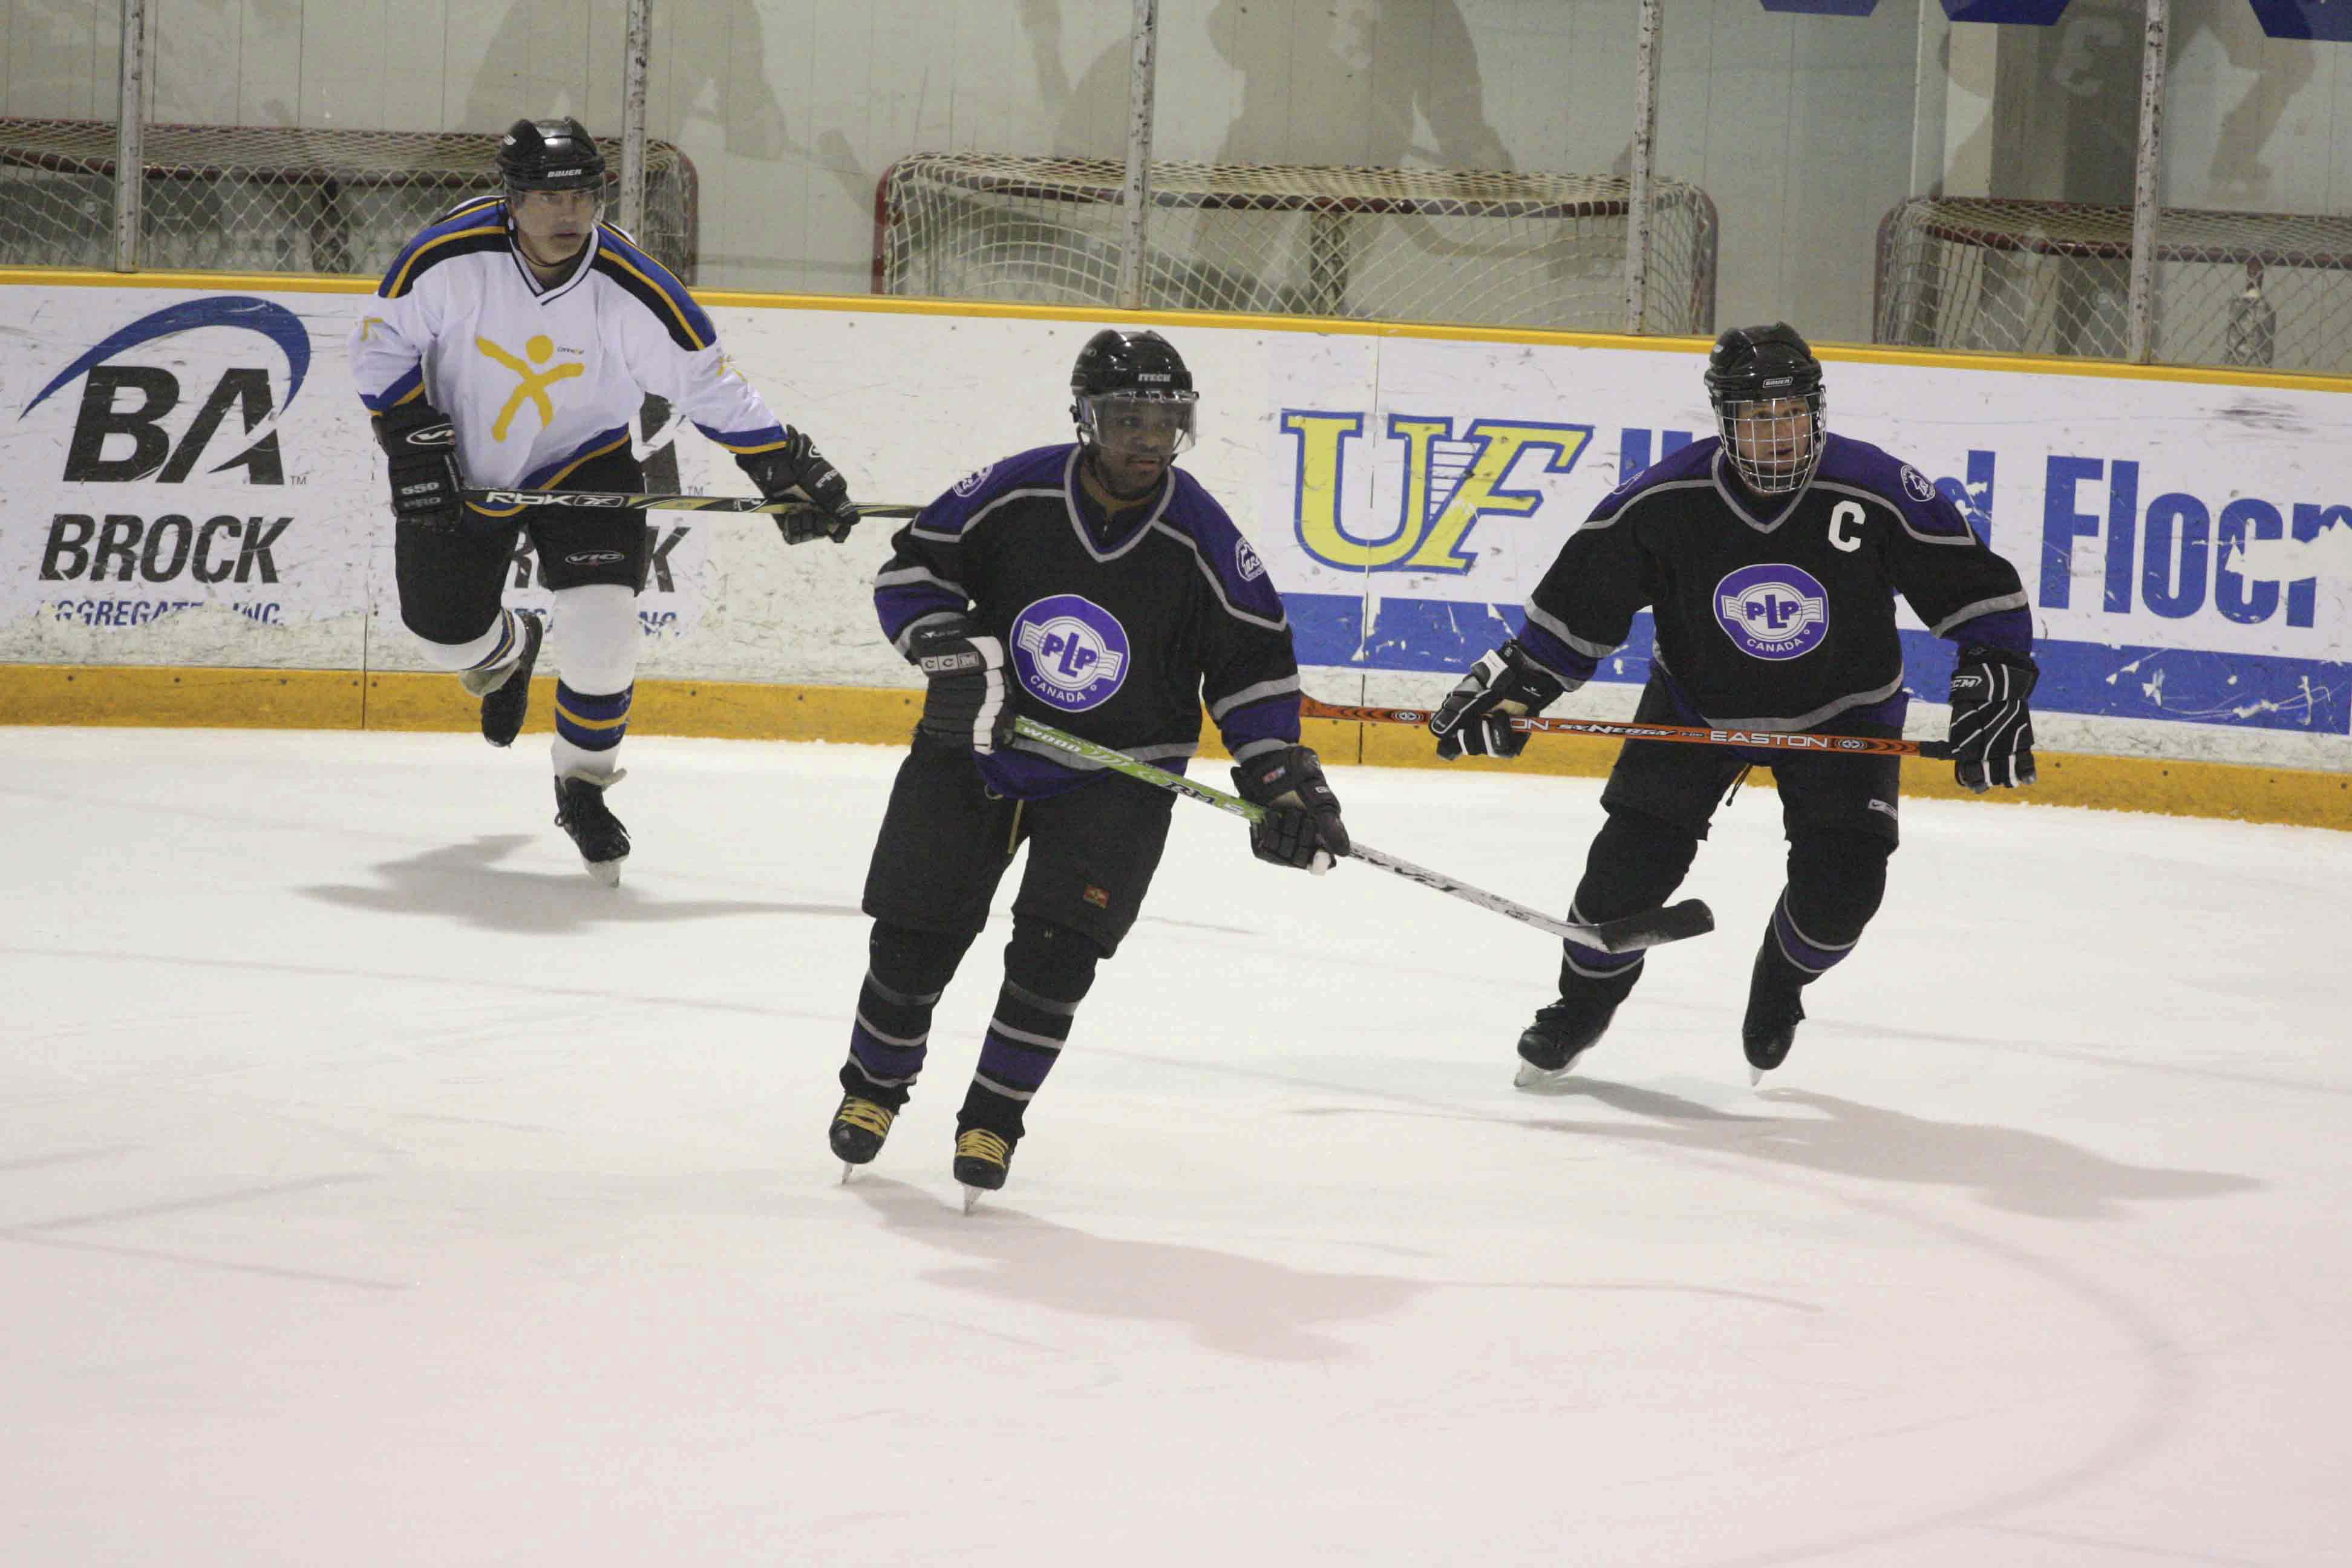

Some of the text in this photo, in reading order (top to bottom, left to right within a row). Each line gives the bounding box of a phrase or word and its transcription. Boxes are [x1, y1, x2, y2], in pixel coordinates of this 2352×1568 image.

[547, 169, 582, 178] BAUER
[1138, 373, 1171, 382] ITECH
[62, 365, 285, 485] BA
[1281, 408, 1595, 575] UF
[1828, 500, 1866, 553] C
[38, 514, 295, 584] BROCK
[1746, 594, 1800, 630] PLP
[1041, 632, 1097, 678] PLP
[1746, 638, 1805, 653] CANADA
[1030, 675, 1086, 702] CANADA
[1710, 730, 1828, 748] EASTON
